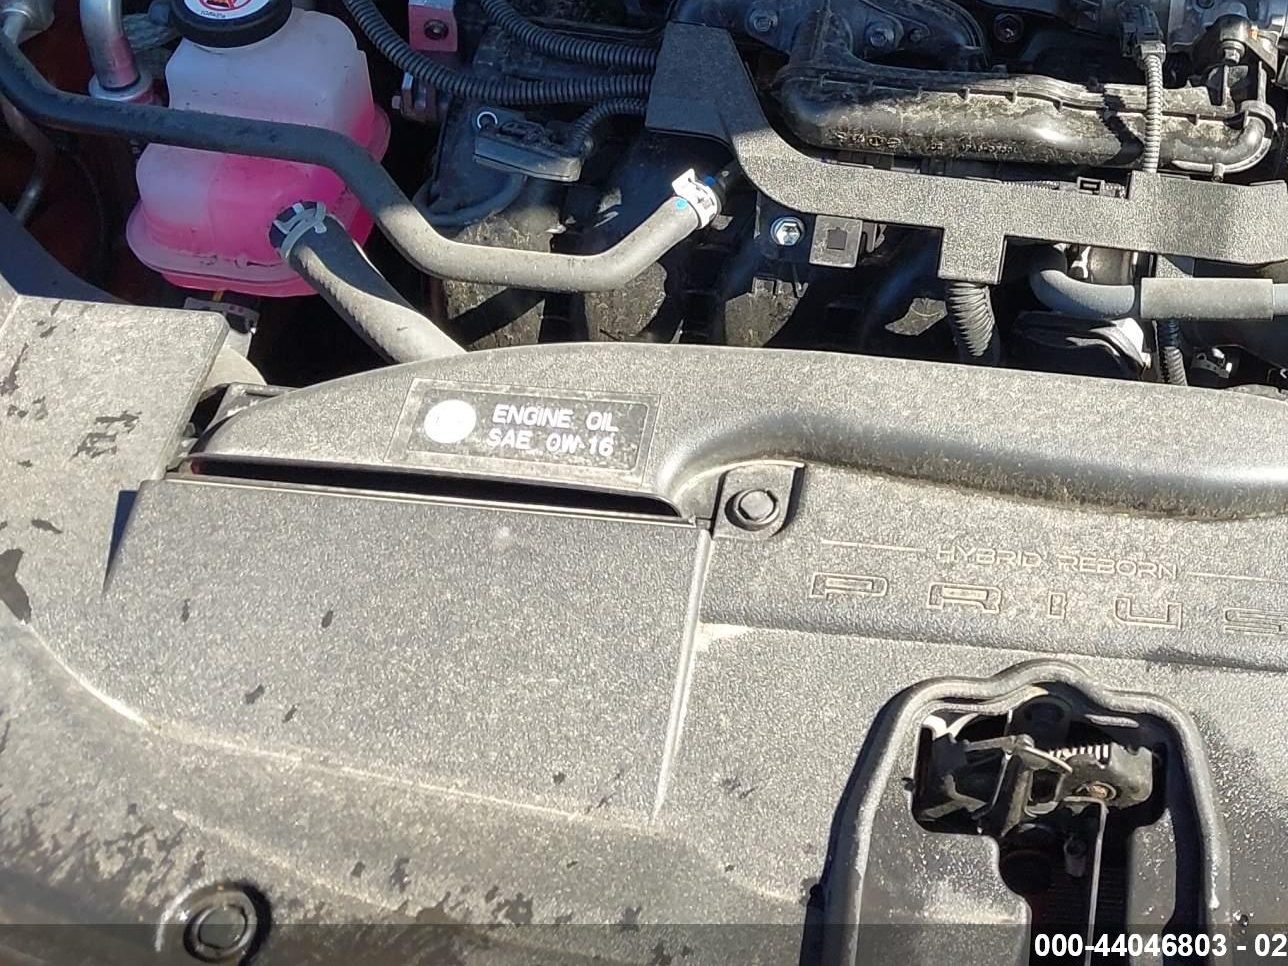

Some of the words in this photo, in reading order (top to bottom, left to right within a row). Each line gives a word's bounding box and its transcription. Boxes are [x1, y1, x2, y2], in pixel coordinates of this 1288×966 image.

[492, 403, 574, 429] ENGINE
[585, 410, 620, 432] OIL
[486, 429, 533, 450] SAE
[934, 544, 1043, 570] HYBRID
[1056, 553, 1178, 580] REBORN
